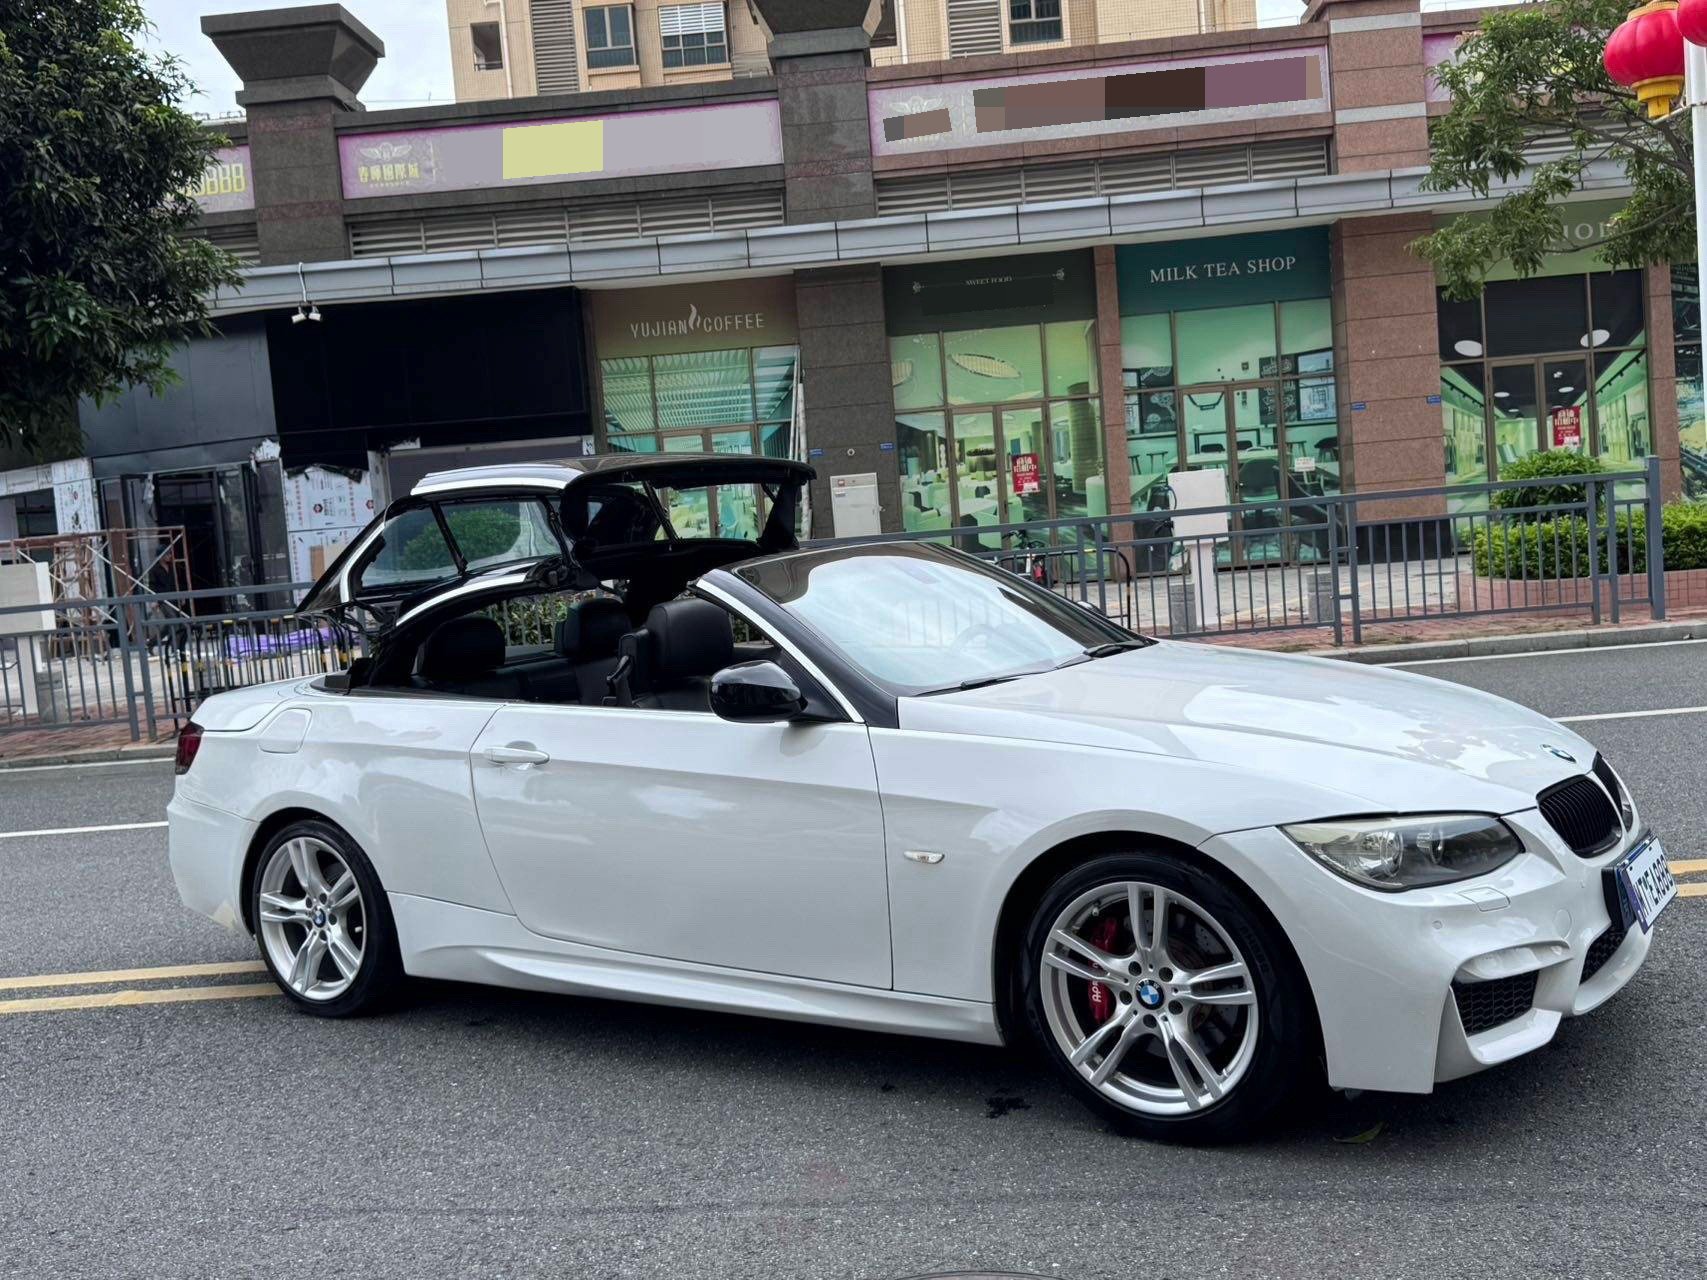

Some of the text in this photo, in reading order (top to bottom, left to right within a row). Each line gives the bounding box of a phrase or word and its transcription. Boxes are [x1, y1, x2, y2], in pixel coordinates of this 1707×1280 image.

[1149, 255, 1296, 283] MILK TEA SHOP
[629, 312, 766, 339] YUJIAN COFFEE
